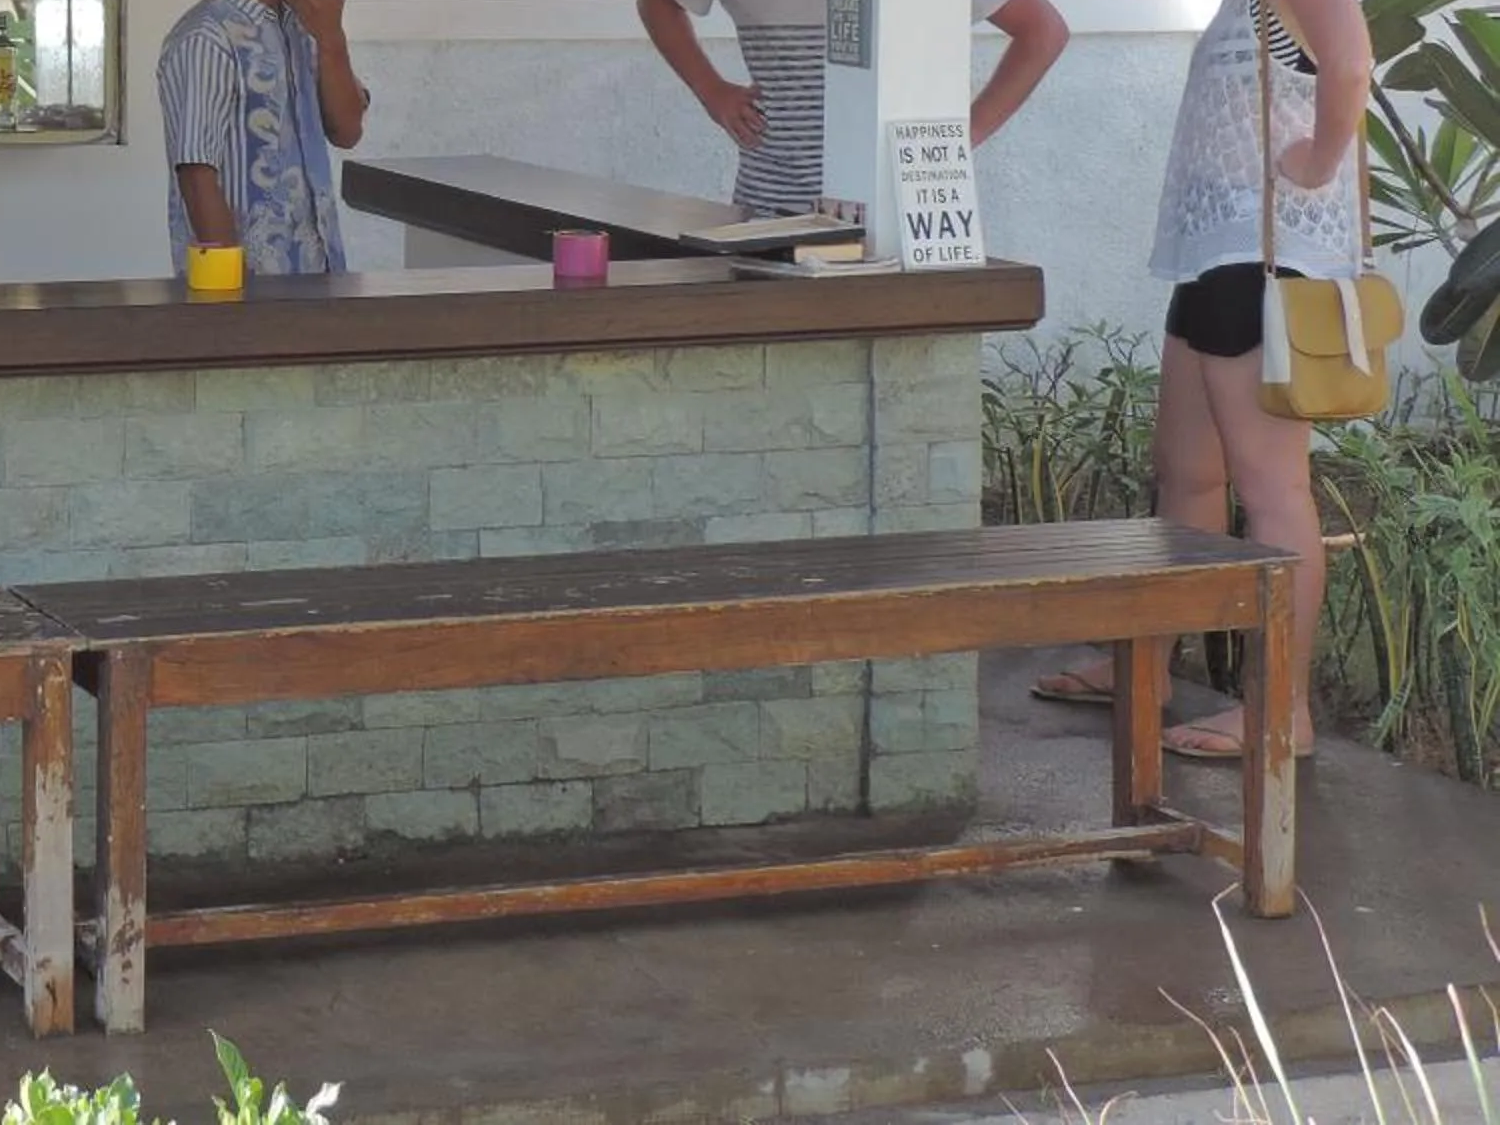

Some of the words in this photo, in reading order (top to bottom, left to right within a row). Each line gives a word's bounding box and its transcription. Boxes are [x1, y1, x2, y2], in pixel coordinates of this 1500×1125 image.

[830, 21, 860, 42] LIFE
[896, 124, 964, 139] HAPPINESS
[899, 147, 913, 164] IS
[921, 146, 949, 162] NOT
[958, 144, 967, 161] A
[916, 188, 928, 204] IT
[932, 188, 947, 204] IS
[951, 188, 959, 203] A
[906, 210, 973, 240] WAY
[913, 246, 932, 263] OF
